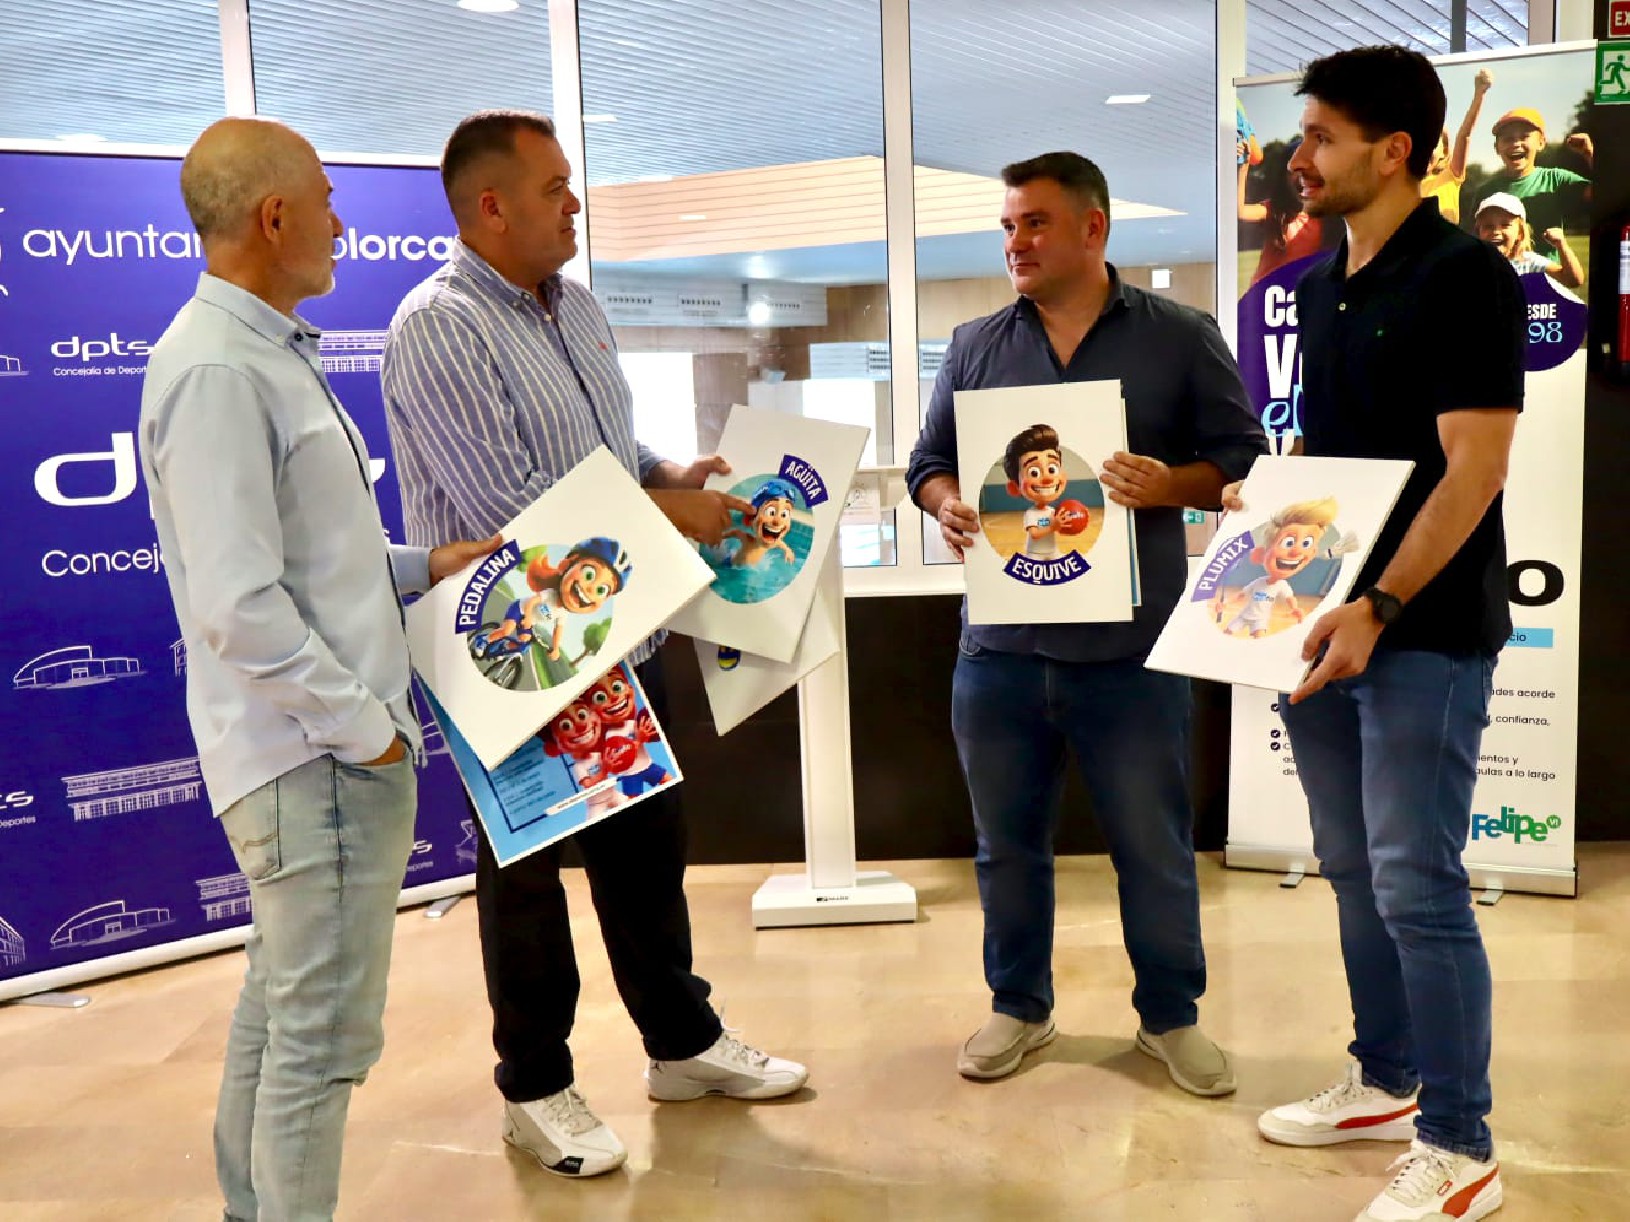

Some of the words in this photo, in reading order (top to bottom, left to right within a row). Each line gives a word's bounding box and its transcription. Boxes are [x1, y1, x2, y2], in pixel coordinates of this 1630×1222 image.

[1527, 303, 1557, 320] ESDE
[1528, 322, 1563, 343] 98
[51, 332, 156, 361] dpts
[103, 367, 116, 375] de
[118, 365, 147, 377] Deport
[41, 542, 165, 577] Concej
[1012, 556, 1082, 584] ESQUIVE
[1199, 537, 1249, 591] PLUMIX
[459, 548, 516, 625] PEDALINA
[1517, 690, 1556, 699] acorde
[1512, 757, 1519, 765] y
[1527, 770, 1556, 782] largo
[1472, 806, 1548, 845] Felipe
